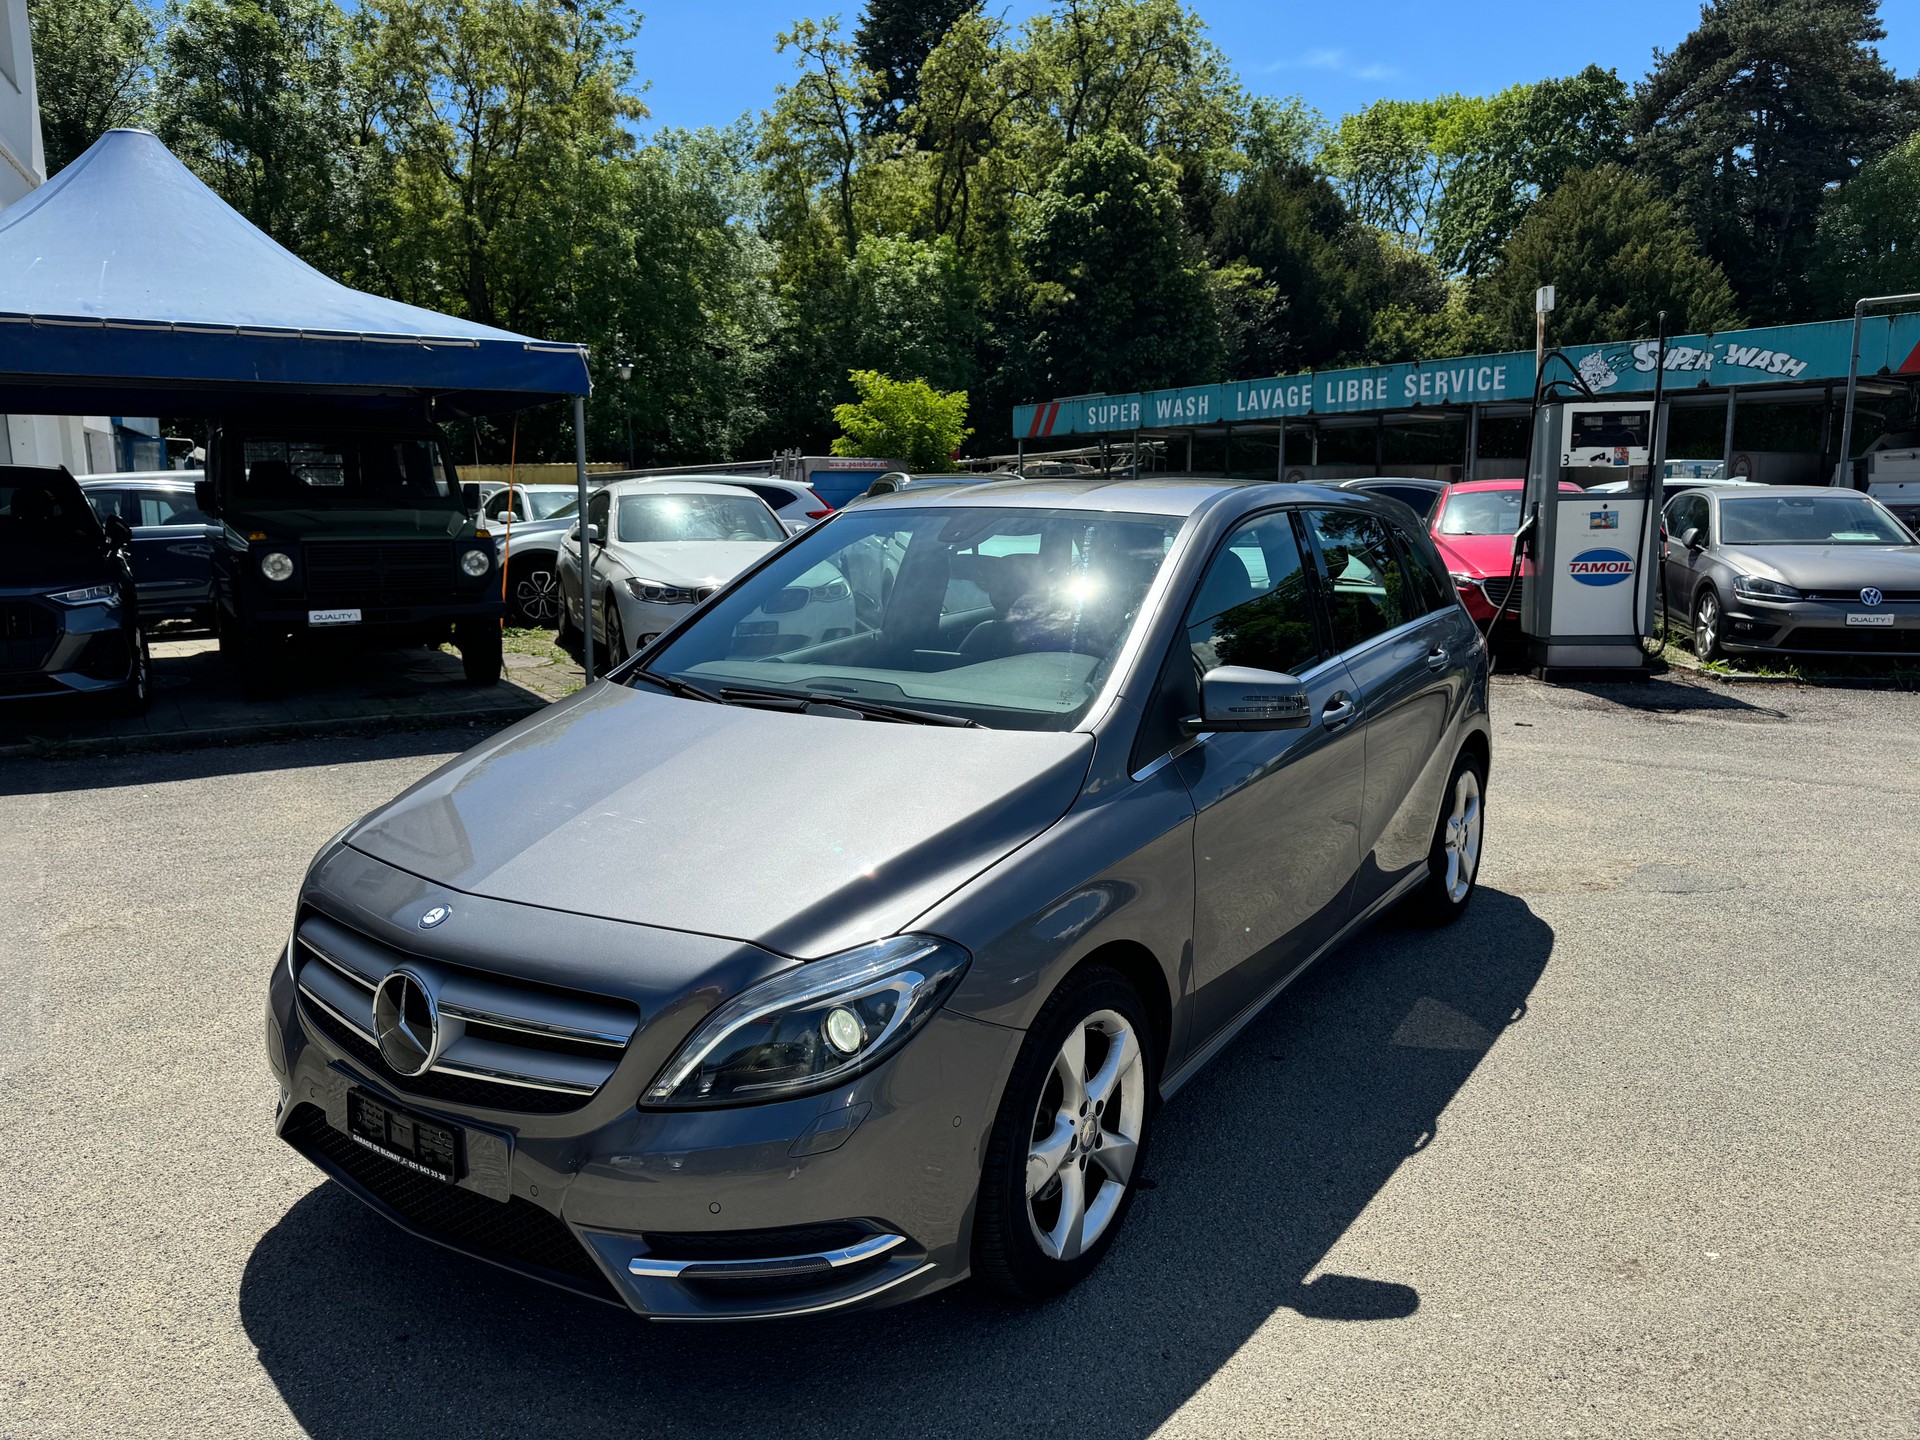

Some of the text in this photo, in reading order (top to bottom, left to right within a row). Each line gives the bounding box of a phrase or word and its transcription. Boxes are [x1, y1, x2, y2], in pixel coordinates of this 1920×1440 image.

[1633, 341, 1807, 377] SUPER WASH
[1088, 365, 1506, 425] SUPER WASH LAVAGE LIBRE SERVICE
[1544, 408, 1550, 423] 3
[1562, 454, 1570, 466] 3
[1569, 562, 1634, 573] TAMOIL
[313, 612, 352, 621] QUALITY
[352, 1134, 373, 1149] GARAGE
[373, 1143, 380, 1153] DE
[380, 1147, 401, 1162] BLONAY
